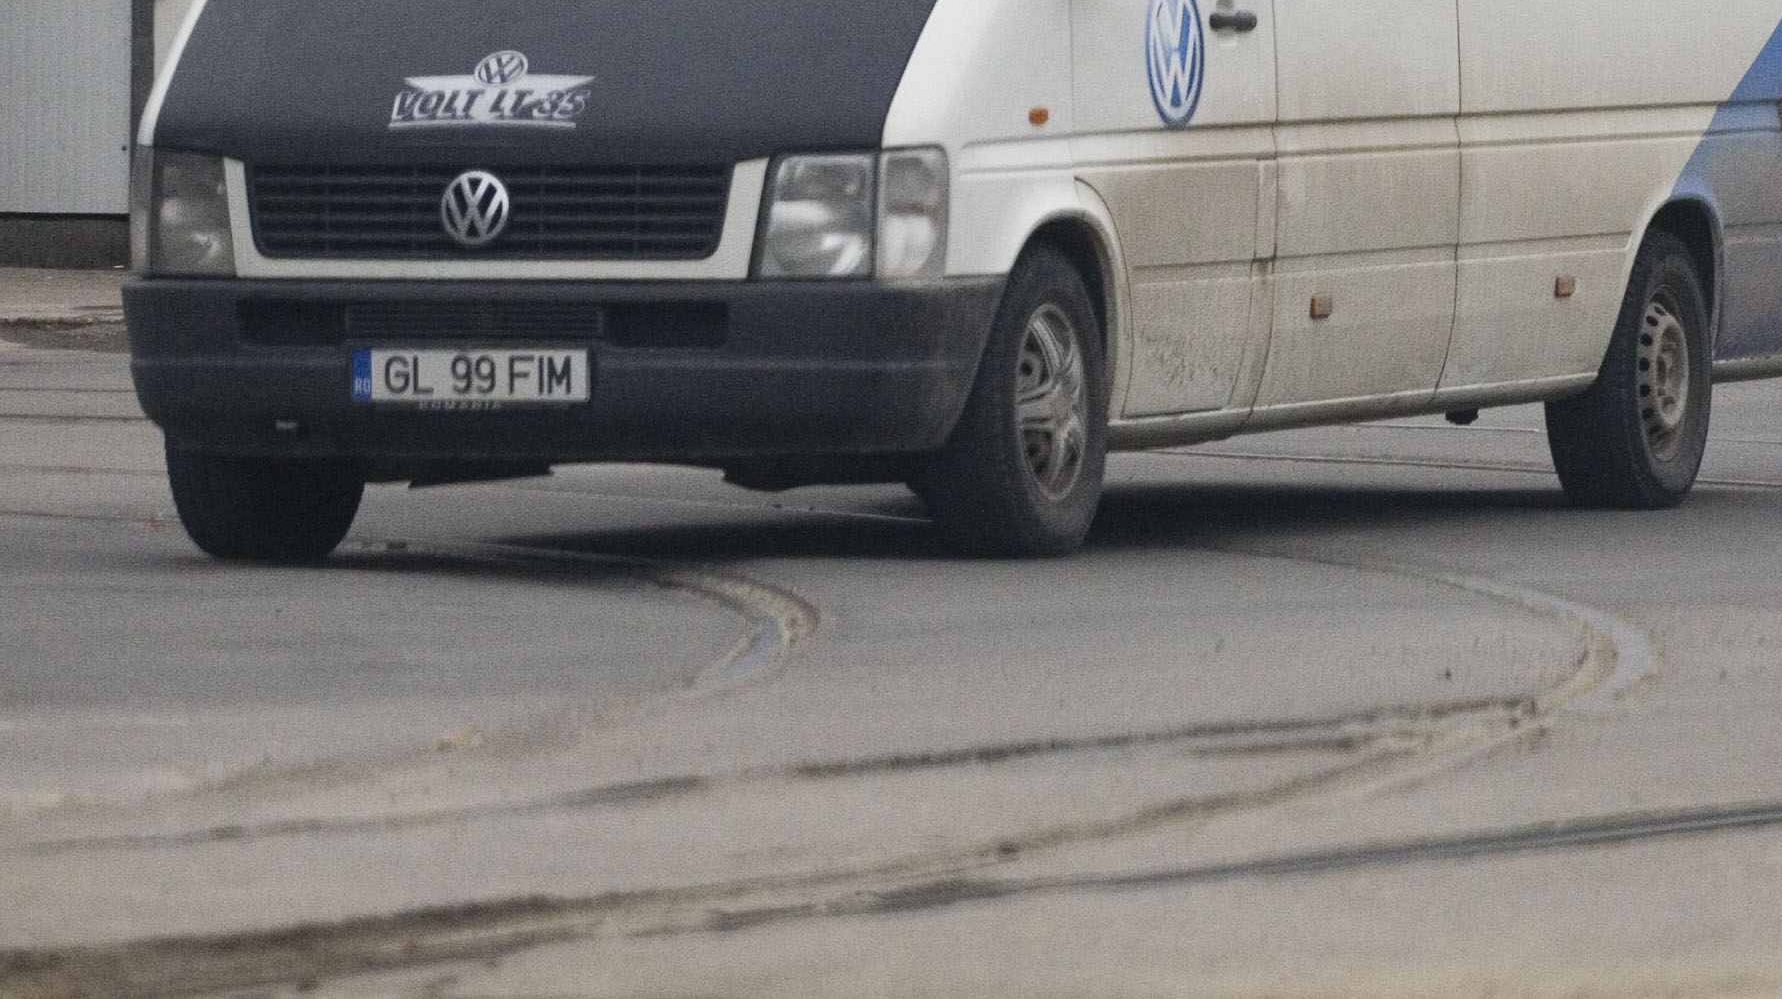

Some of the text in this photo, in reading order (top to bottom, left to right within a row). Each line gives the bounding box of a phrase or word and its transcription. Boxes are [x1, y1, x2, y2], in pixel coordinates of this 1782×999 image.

[391, 90, 487, 120] VOLT
[354, 379, 371, 395] RO
[384, 355, 572, 395] GL 99 FIM
